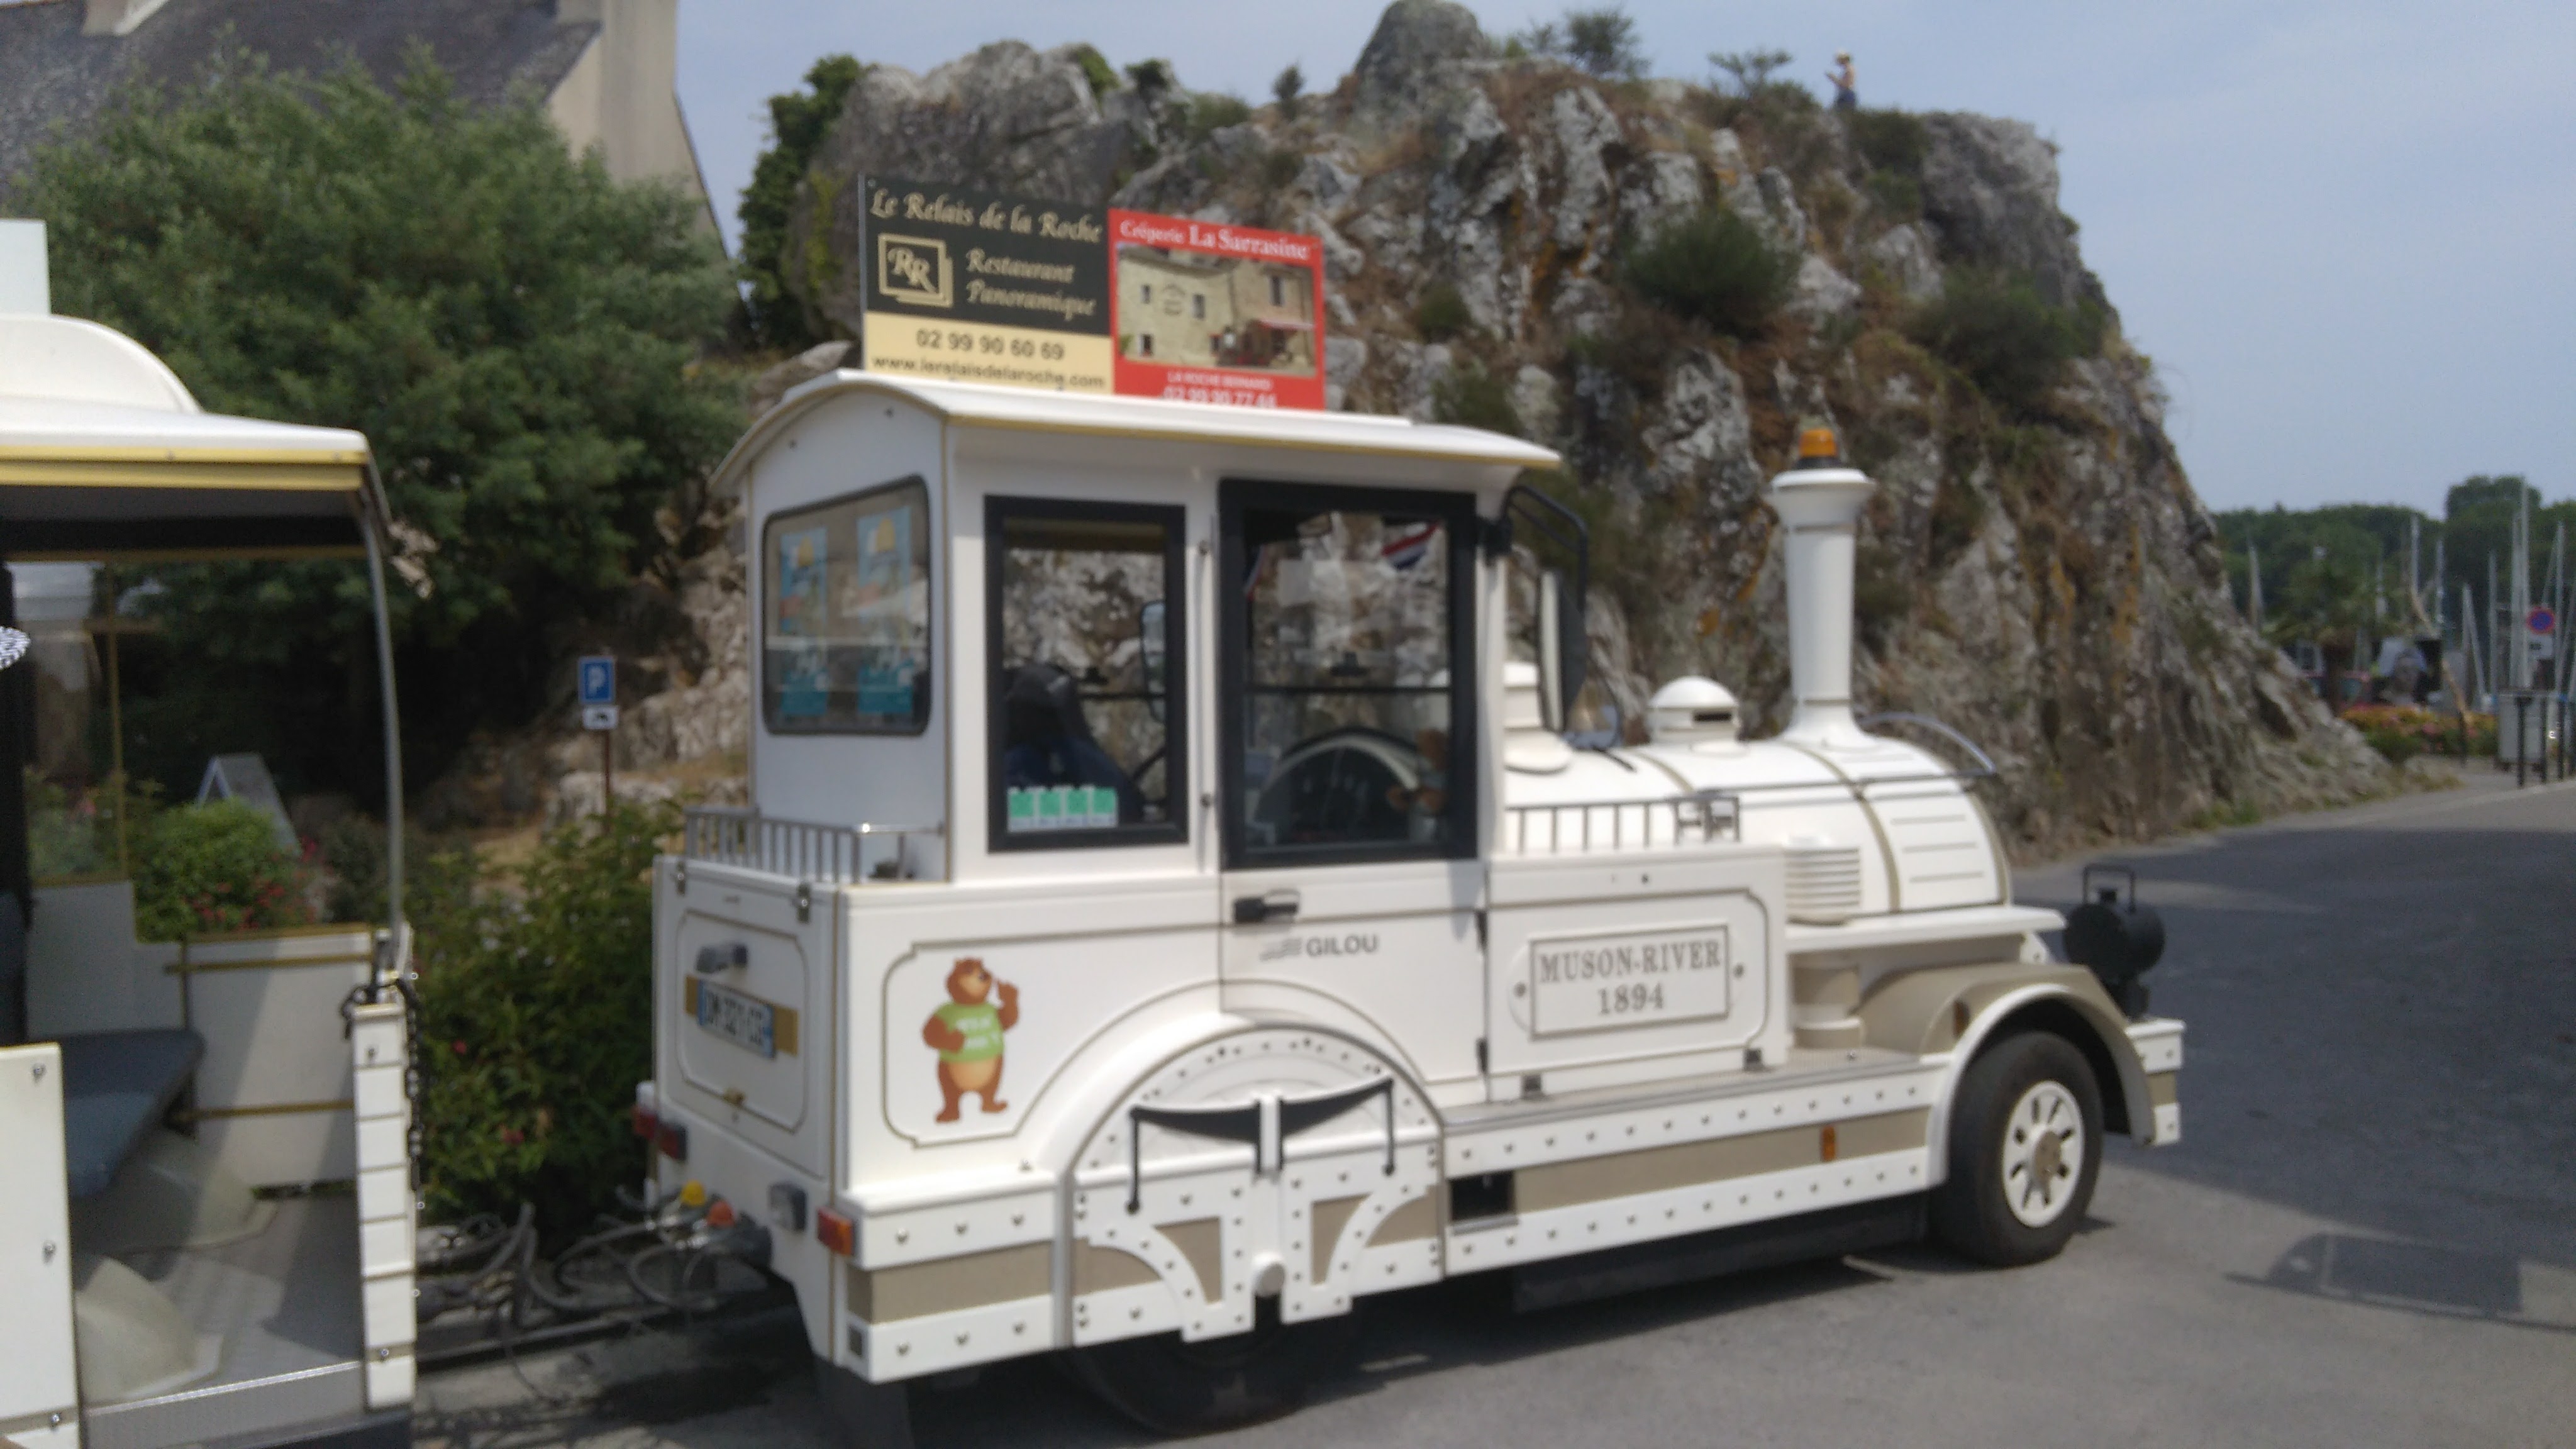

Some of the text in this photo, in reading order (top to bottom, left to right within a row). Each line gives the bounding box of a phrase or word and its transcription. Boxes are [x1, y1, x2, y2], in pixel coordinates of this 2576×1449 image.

[870, 188, 1102, 243] Le Relais de la Roche
[1189, 223, 1216, 248] La
[965, 247, 1075, 283] Restaurant
[965, 279, 1097, 321] Panoramique
[916, 328, 1065, 361] 02 99 90 60 69
[588, 666, 605, 695] P
[1306, 933, 1379, 957] GILOU
[1538, 940, 1722, 984] MUSON-RIVER
[1597, 980, 1665, 1017] 1894
